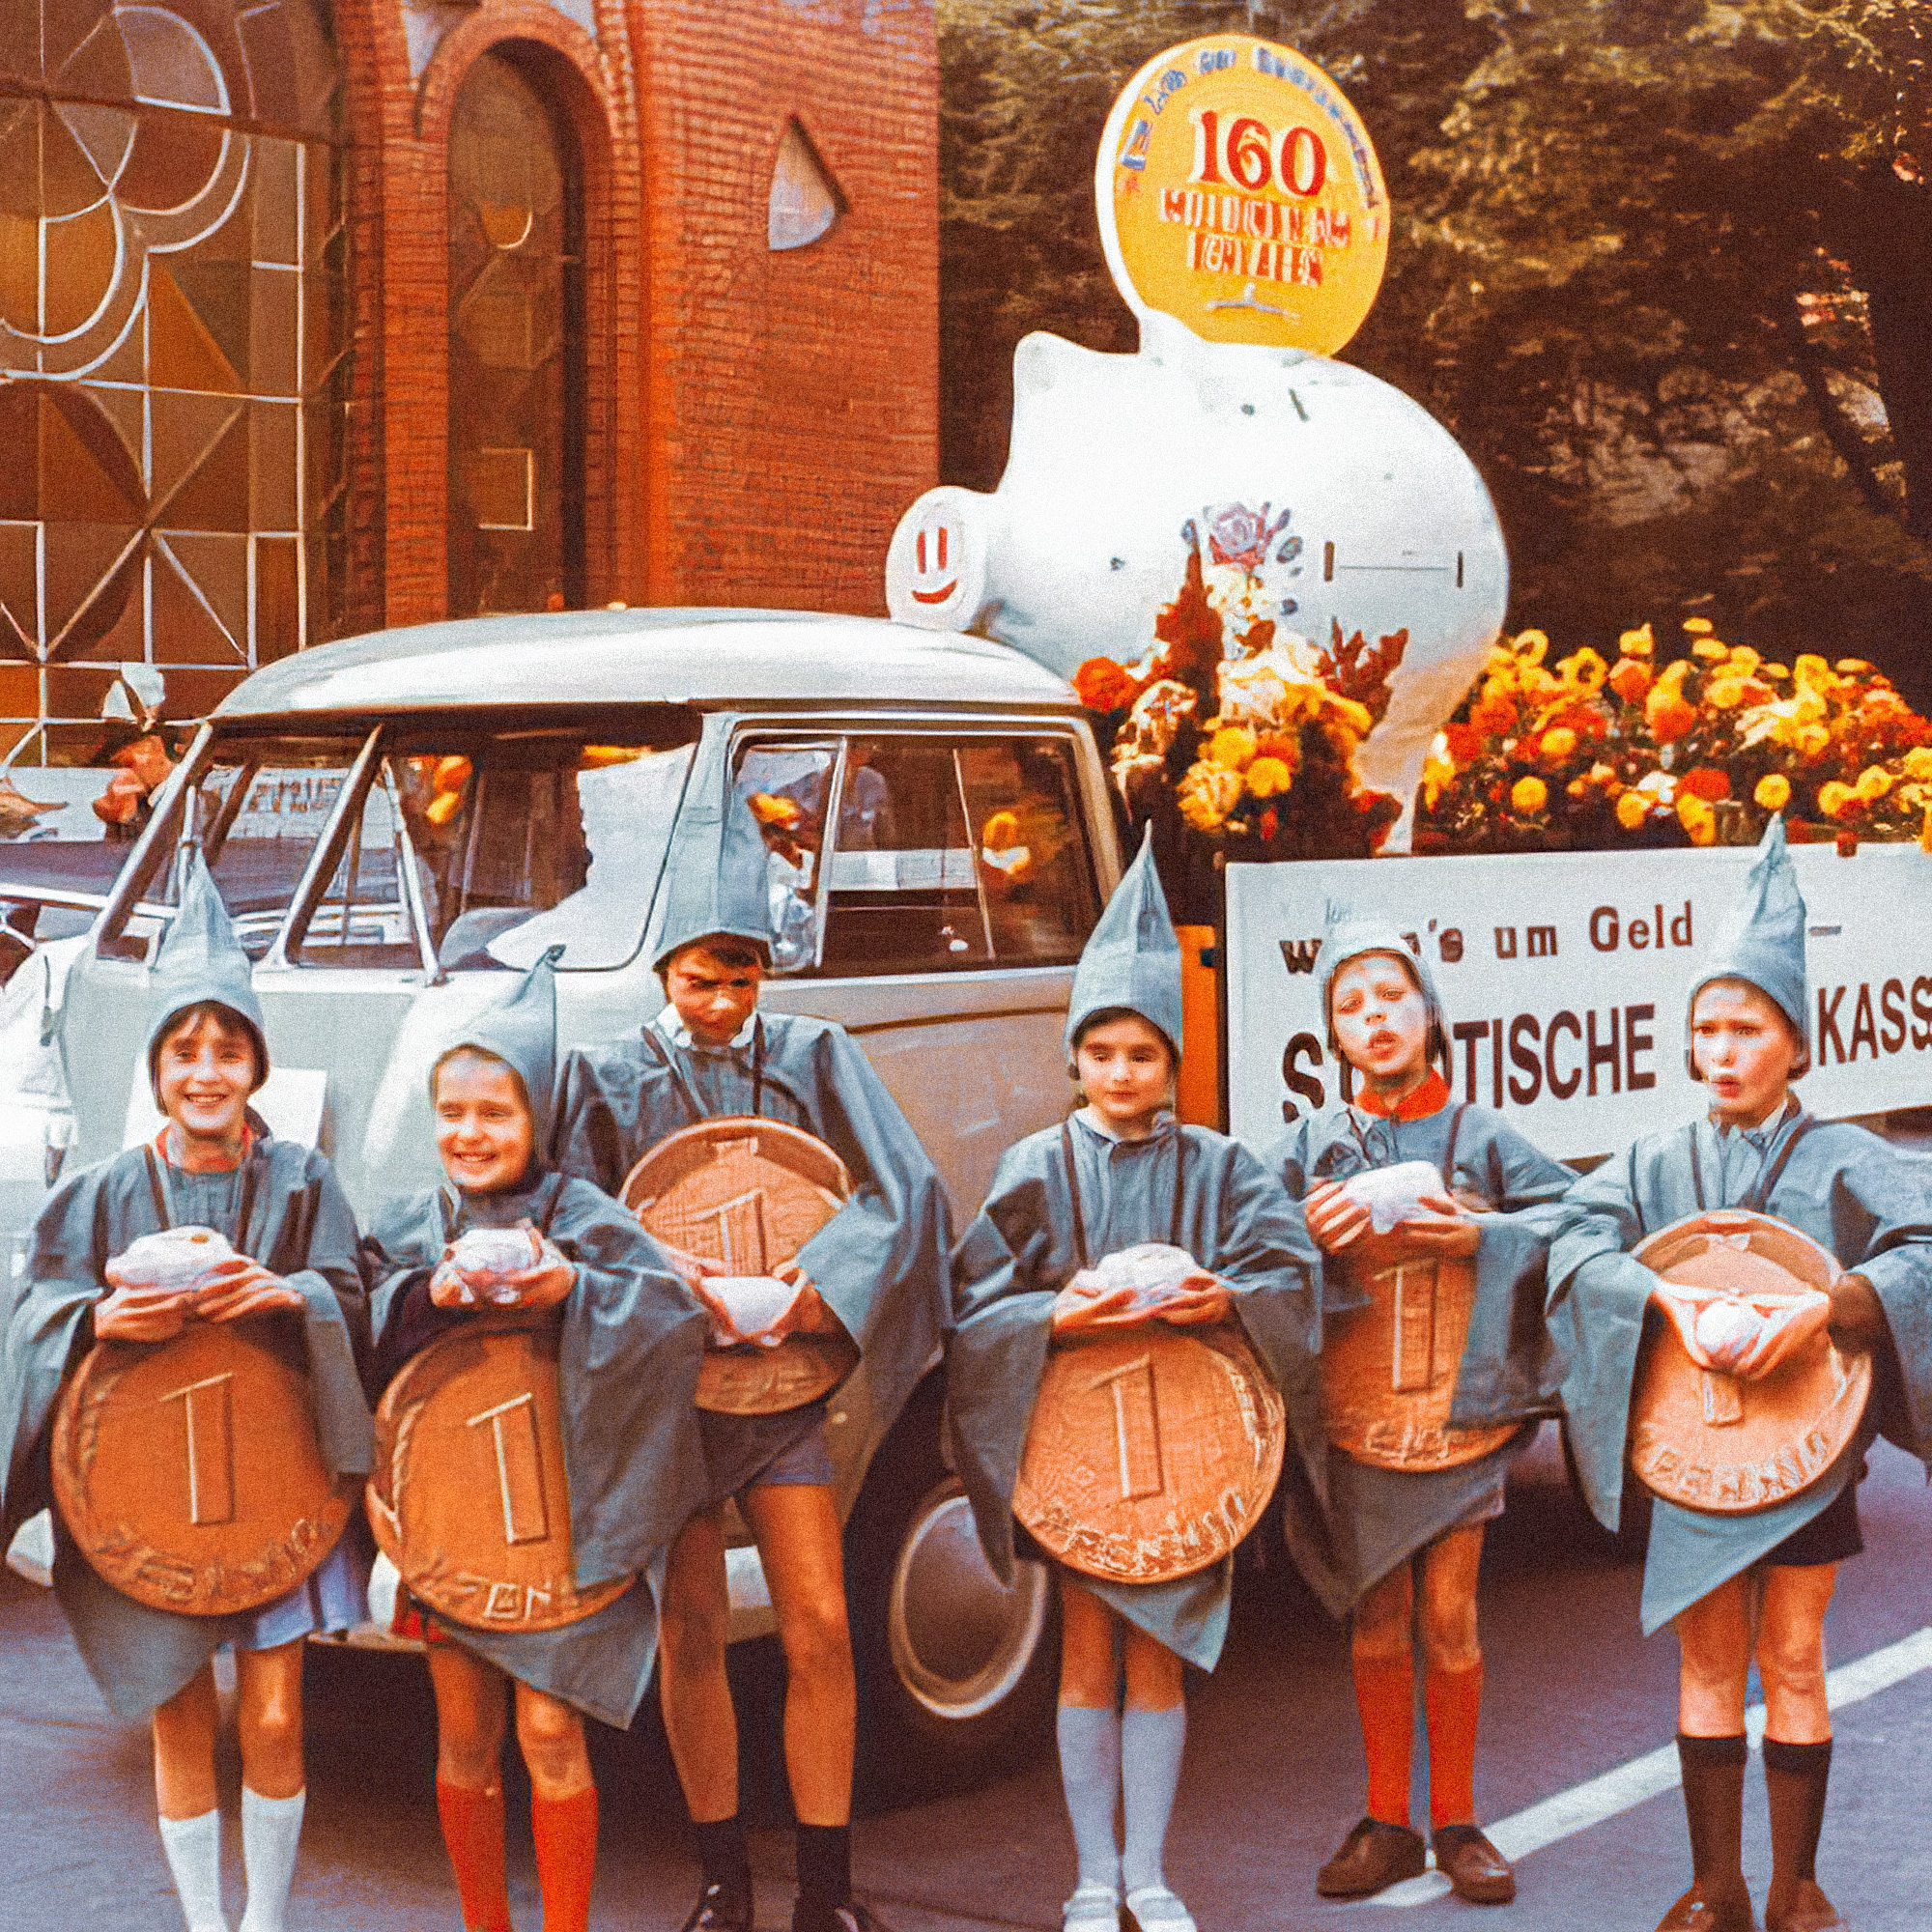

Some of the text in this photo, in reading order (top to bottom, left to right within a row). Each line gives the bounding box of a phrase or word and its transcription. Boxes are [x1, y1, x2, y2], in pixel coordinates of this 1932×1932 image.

[1189, 108, 1328, 198] 160
[1493, 925, 1558, 959] um
[1589, 899, 1693, 952] Geld
[1283, 1003, 1657, 1123] STISCHE
